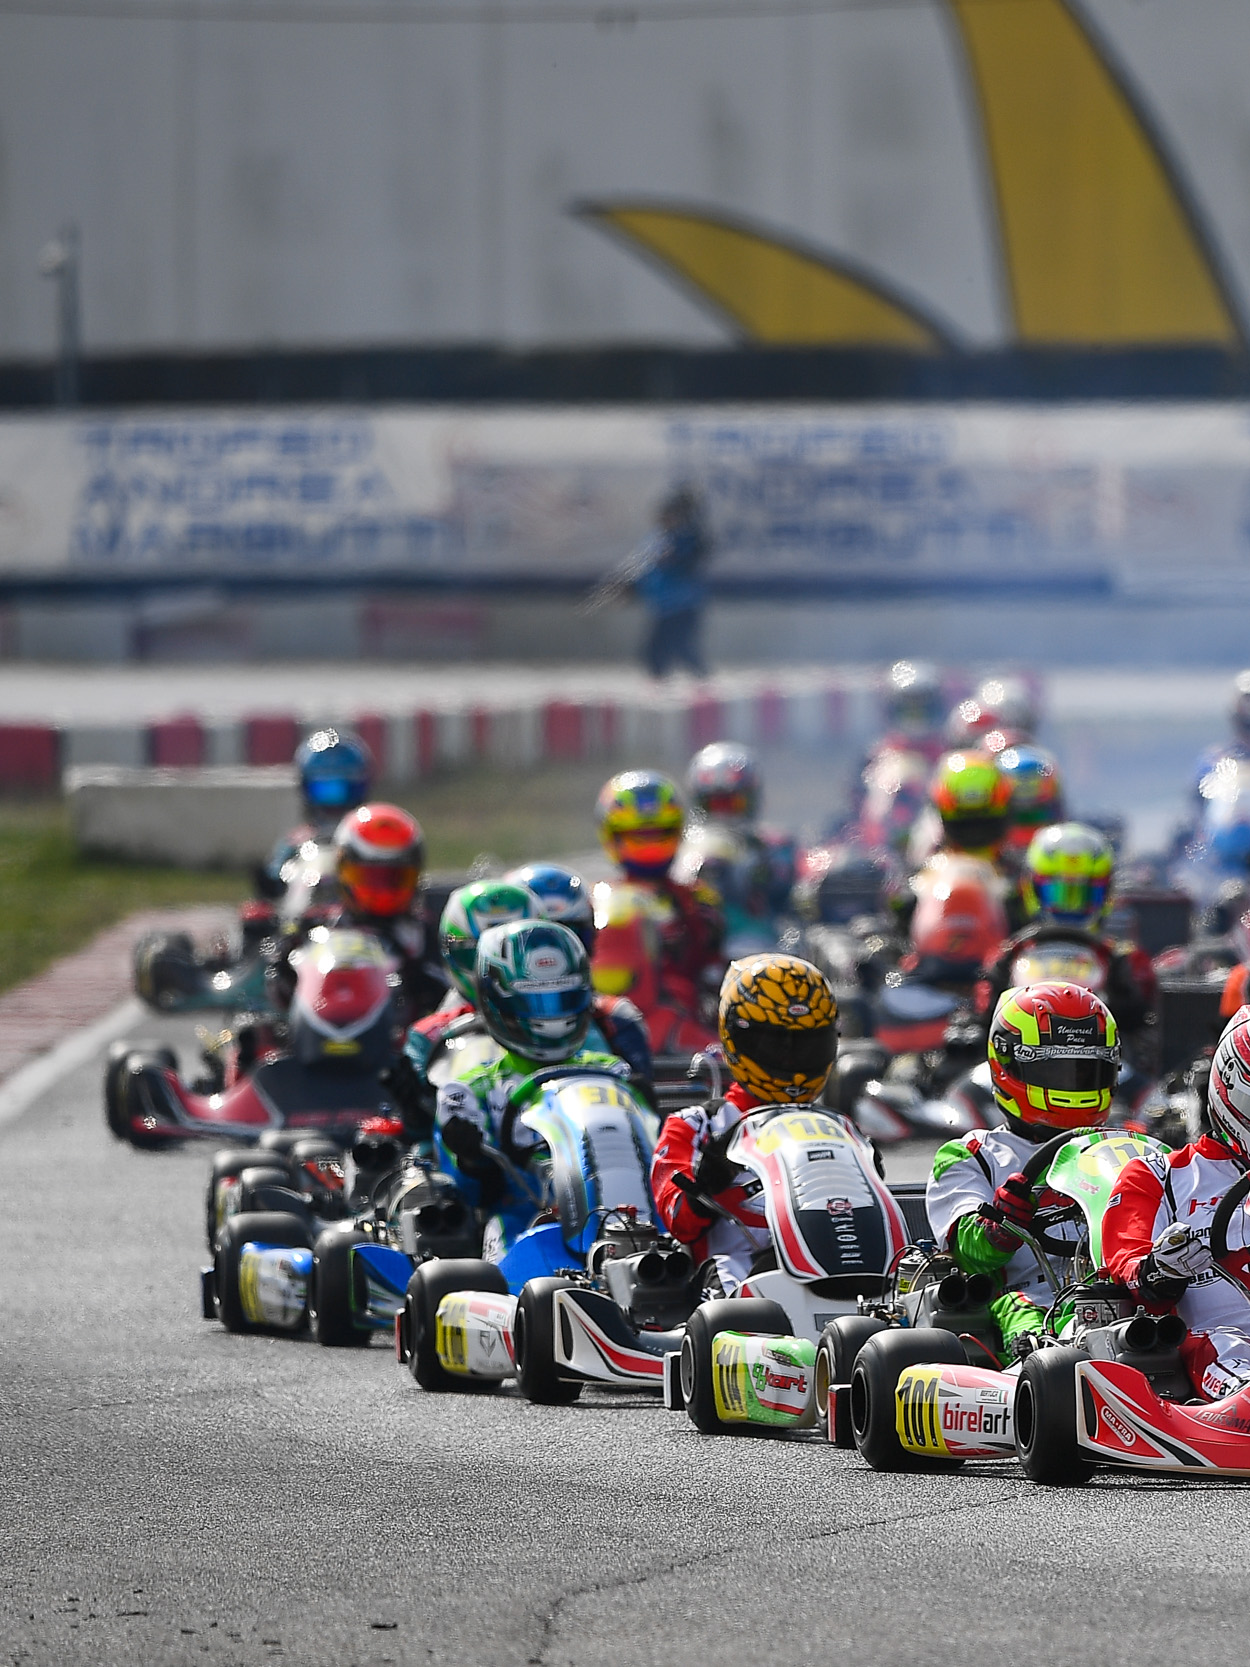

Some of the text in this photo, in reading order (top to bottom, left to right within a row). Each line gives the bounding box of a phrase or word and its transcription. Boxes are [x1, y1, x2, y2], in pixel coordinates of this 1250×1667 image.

[1057, 1025, 1094, 1035] Universal
[1014, 1046, 1036, 1058] Arai
[768, 1119, 844, 1140] 116
[897, 1376, 939, 1448] 101
[943, 1402, 1011, 1435] birelart
